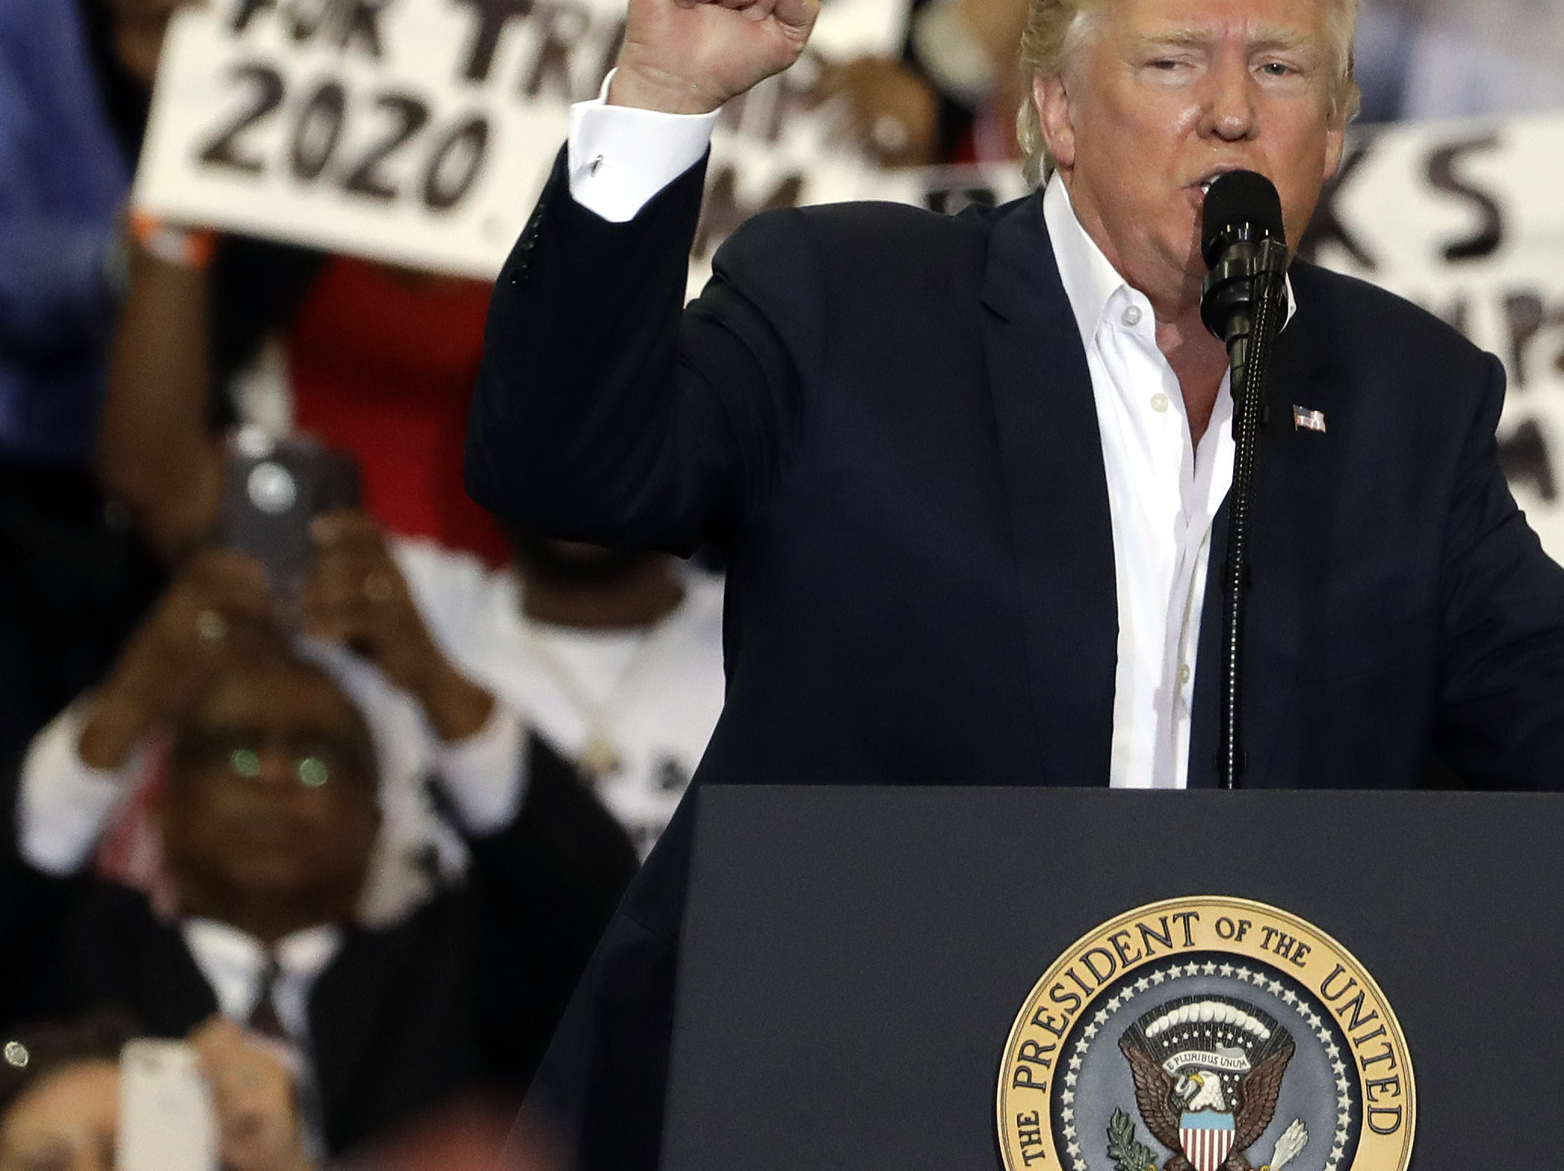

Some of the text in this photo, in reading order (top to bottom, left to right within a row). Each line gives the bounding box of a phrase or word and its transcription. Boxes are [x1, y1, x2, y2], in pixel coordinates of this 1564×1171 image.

[1012, 911, 1401, 1167] THE PRESIDENT OF THE UNITED
[1166, 1052, 1248, 1071] E PLURIBUS UNUM
